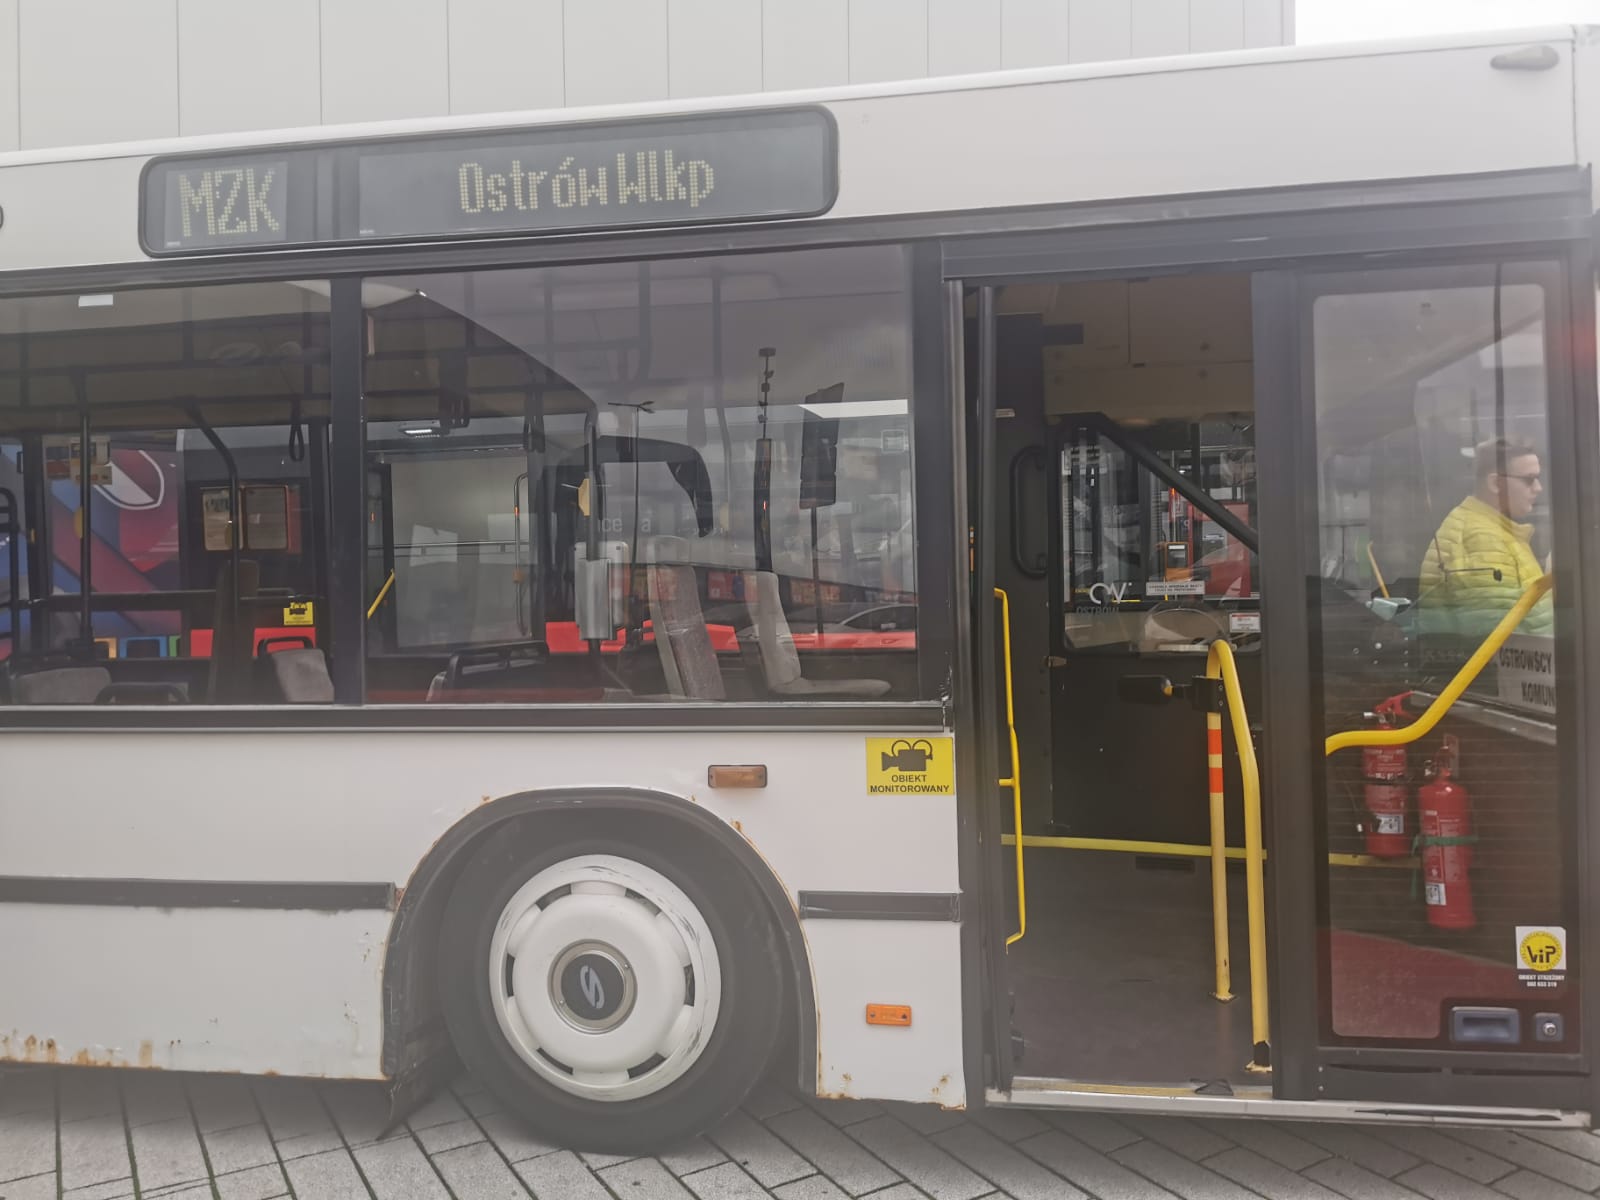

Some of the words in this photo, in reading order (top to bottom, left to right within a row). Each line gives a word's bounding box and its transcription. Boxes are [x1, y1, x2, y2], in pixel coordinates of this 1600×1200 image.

[458, 155, 608, 213] Ostrów
[616, 149, 715, 208] Wlkp
[178, 167, 280, 237] MZK
[870, 784, 950, 793] MONITOROWANY
[891, 774, 927, 783] OBIEKT
